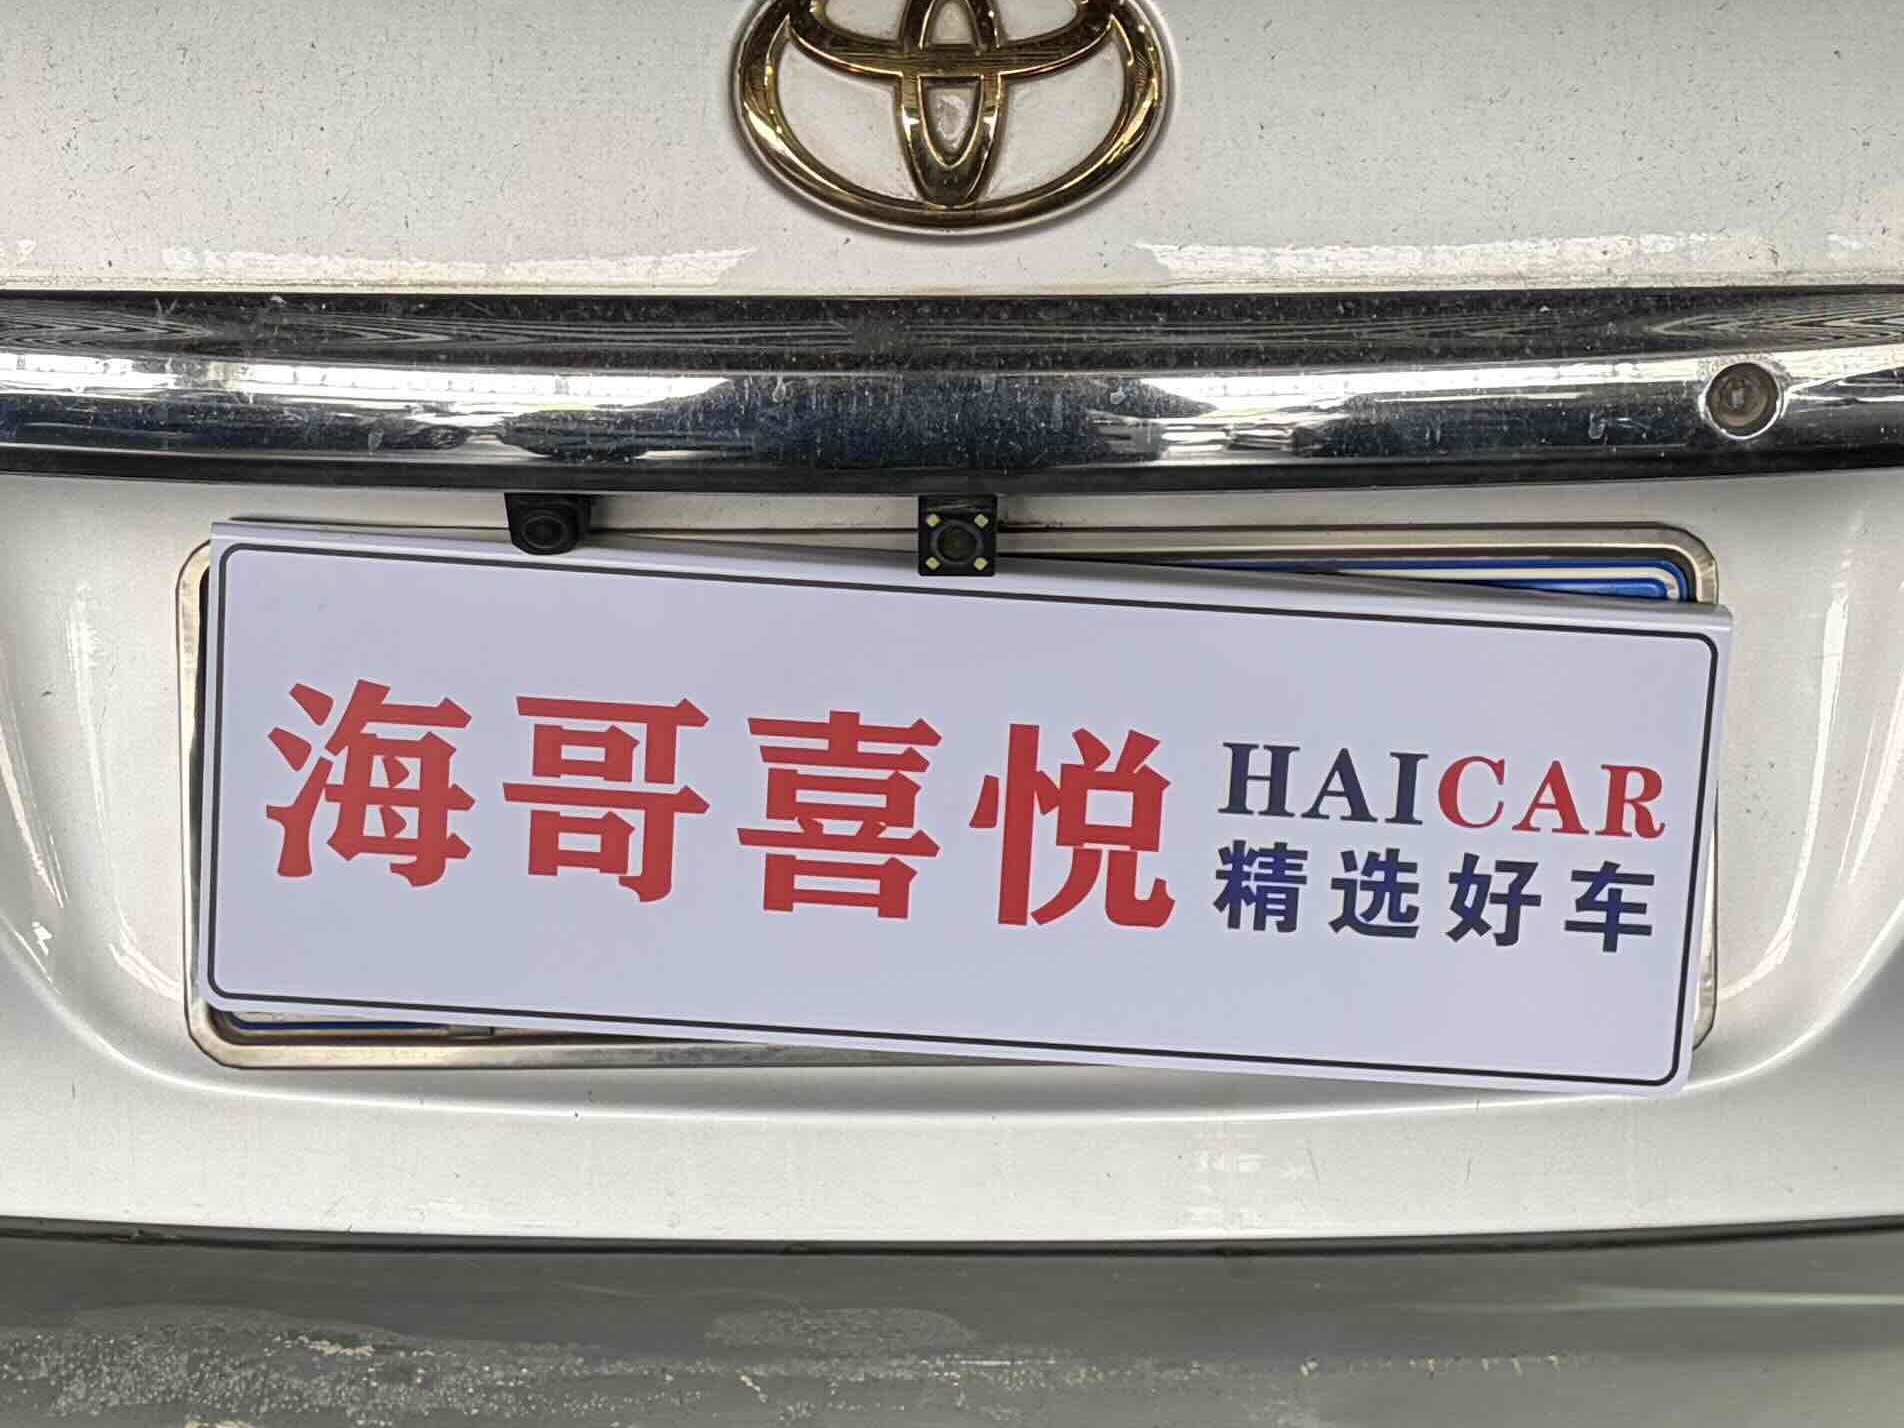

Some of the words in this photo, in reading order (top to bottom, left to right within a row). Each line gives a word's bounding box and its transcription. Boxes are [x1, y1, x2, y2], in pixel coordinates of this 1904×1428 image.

[264, 677, 1179, 931] 海哥喜悦
[1217, 741, 1667, 839] HAICAR
[1212, 838, 1658, 953] 精选好车
